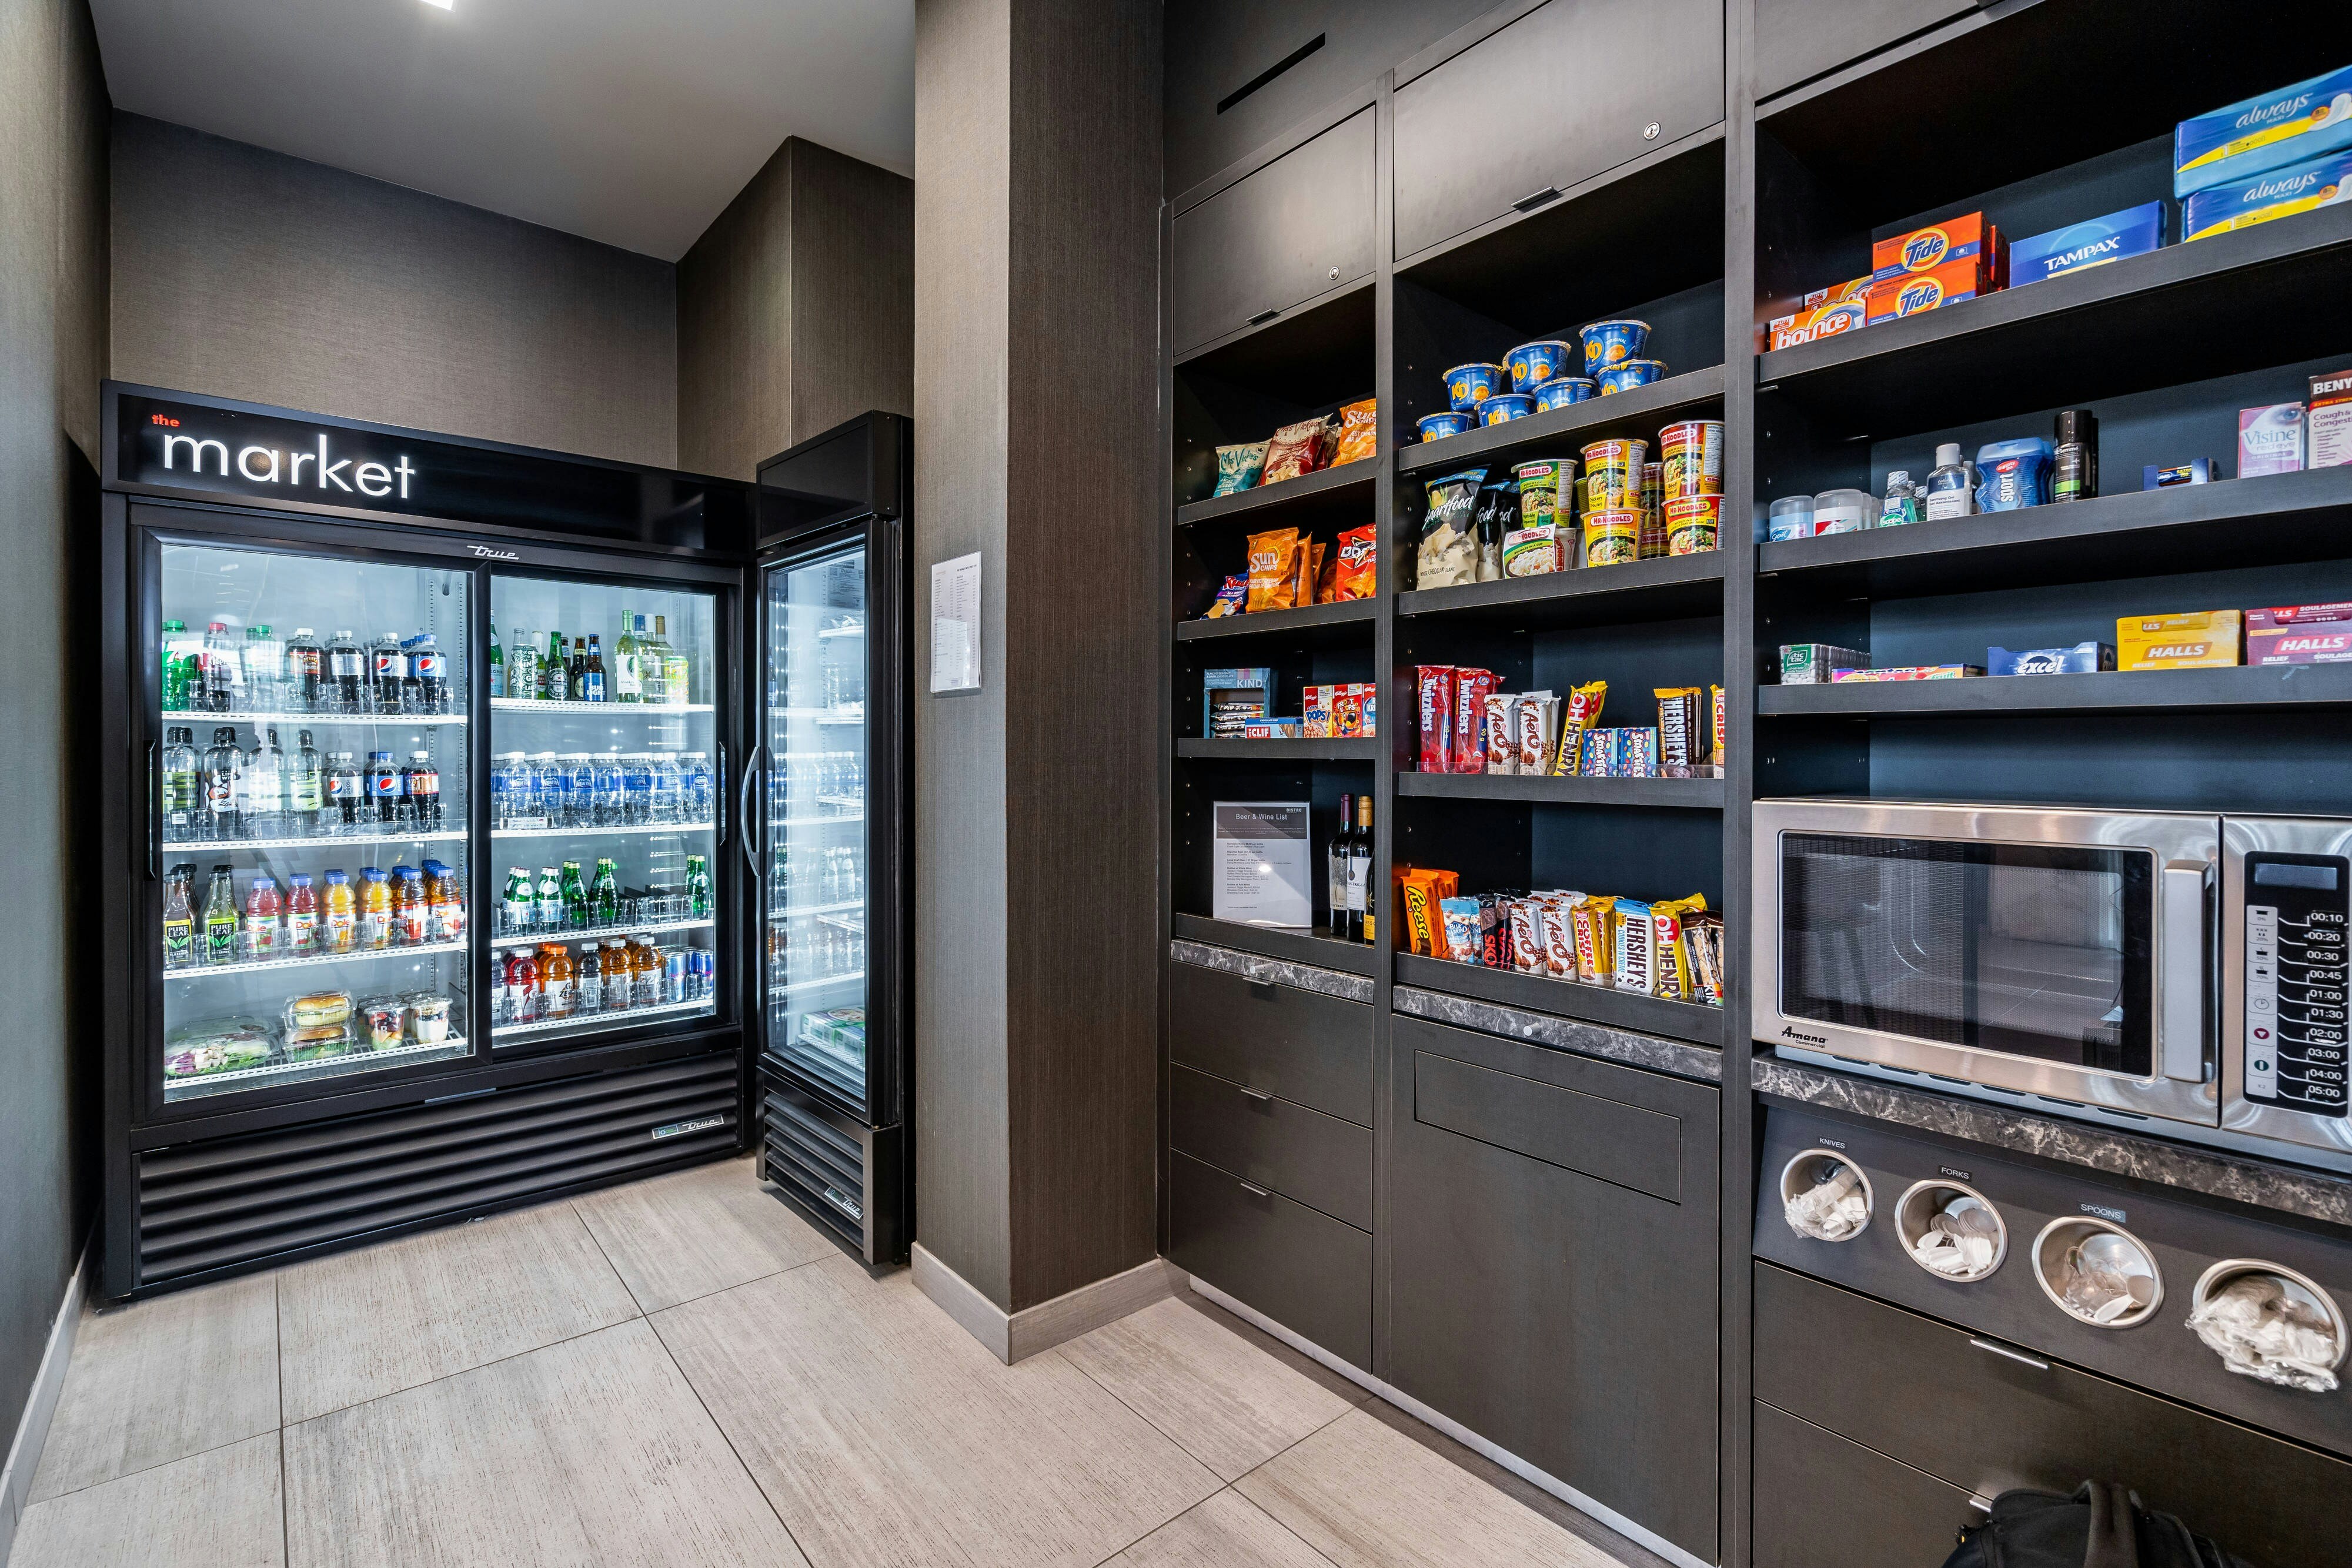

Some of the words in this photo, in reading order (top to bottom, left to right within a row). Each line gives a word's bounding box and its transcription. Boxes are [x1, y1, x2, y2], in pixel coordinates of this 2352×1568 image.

[2236, 92, 2313, 129] always
[2243, 170, 2321, 203] always
[1905, 235, 1946, 269] Tide
[2044, 236, 2120, 271] TAMPAX
[1900, 286, 1939, 317] Tide
[1777, 315, 1846, 350] bounce
[1606, 337, 1627, 345] ORIGINAL
[1585, 340, 1603, 362] KD
[1531, 357, 1550, 365] ORIGINAL
[1511, 362, 1528, 383] KD
[1621, 377, 1642, 386] ORIGINAL
[2313, 379, 2352, 394] BENY
[1452, 381, 1469, 402] KD
[1552, 396, 1571, 404] ORIGINAL
[152, 414, 181, 427] the
[1488, 409, 1509, 426] KD
[2314, 410, 2343, 420] Cough
[2314, 417, 2352, 428] Congest
[2243, 429, 2296, 446] Visine
[163, 433, 416, 499] market
[1999, 472, 2014, 503] sport
[1250, 552, 1280, 573] Sun
[2274, 609, 2293, 617] LLS
[2148, 645, 2206, 658] HALLS
[2281, 637, 2346, 651] HALLS
[2314, 651, 2352, 660] SOULAGE
[2017, 656, 2064, 675] excel
[1237, 679, 1262, 688] KIND
[1421, 676, 1439, 732] Twizzlers
[1458, 677, 1475, 734] Twizzlers
[1569, 693, 1586, 721] OH
[1251, 728, 1269, 737] CLIF
[1406, 886, 1429, 940] Reese
[2311, 912, 2343, 922] 00:10
[1656, 915, 1675, 945] OH
[2309, 932, 2340, 942] 00:20
[1576, 920, 1586, 958] CRISP
[1583, 920, 1593, 966] COFFEE
[1626, 917, 1646, 990] HERSHEY'S
[2307, 950, 2338, 961] 00:30
[1658, 946, 1681, 999] HENR
[2310, 970, 2342, 980] 00:45
[1705, 985, 1716, 1005] KIN
[2310, 989, 2341, 1001] 01:00
[2311, 1008, 2343, 1019] 01:30
[1781, 1027, 1827, 1044] Amana
[2310, 1029, 2342, 1040] 02:00
[1795, 1039, 1825, 1048] Commercial
[2308, 1048, 2340, 1059] 03:00
[2310, 1068, 2342, 1081] 04:00
[2309, 1085, 2340, 1098] 05:00
[1819, 1137, 1845, 1149] KNIVES
[1941, 1166, 1969, 1179] FORKS
[2080, 1203, 2122, 1219] SPOONS
